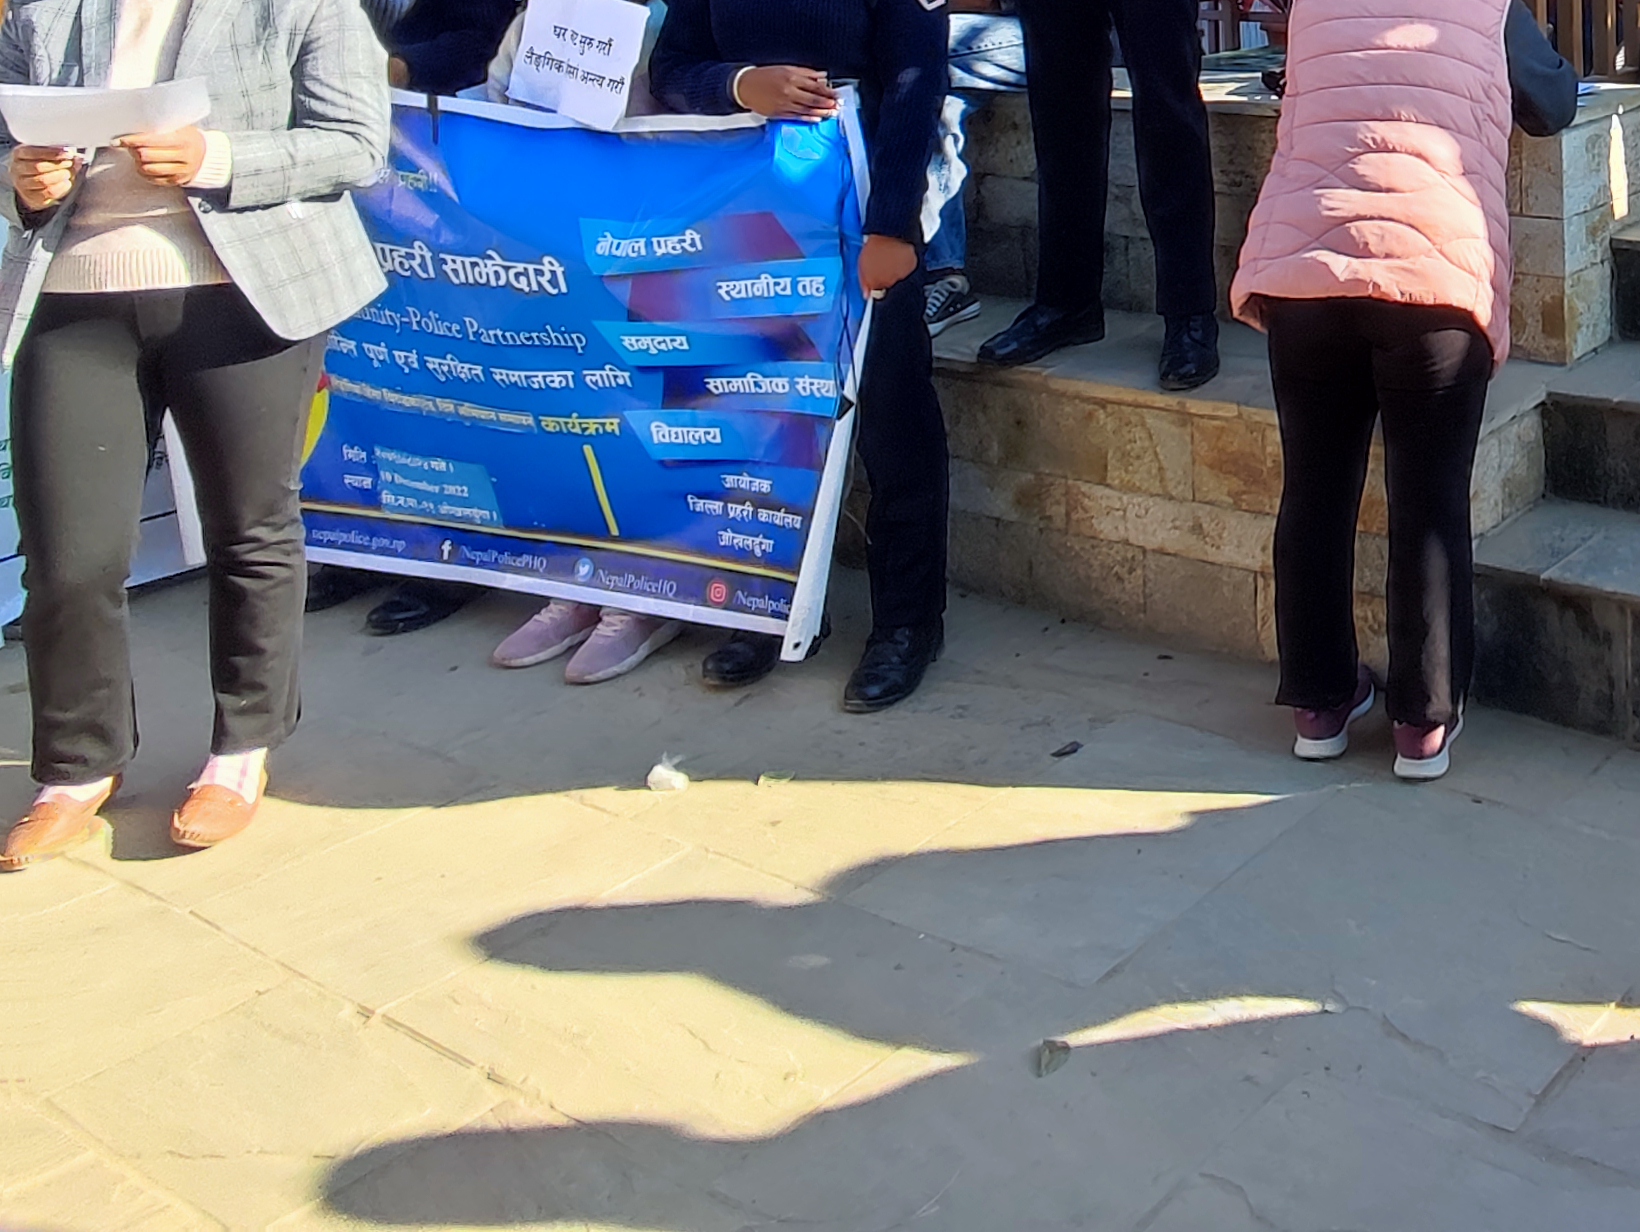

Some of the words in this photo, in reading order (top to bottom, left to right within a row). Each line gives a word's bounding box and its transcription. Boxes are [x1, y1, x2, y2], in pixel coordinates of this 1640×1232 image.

[595, 232, 646, 257] नेपाल
[652, 229, 703, 257] प्रहरी
[373, 240, 436, 280] प्रहरी
[439, 249, 569, 295] साझेदारी
[716, 274, 792, 302] स्थानीय
[797, 276, 826, 297] तह
[464, 317, 588, 353] Partnership
[620, 335, 690, 355] समुदाय
[582, 363, 633, 390] लागि
[704, 373, 789, 396] सामाजिक
[539, 413, 621, 437] कार्यक्रम
[650, 421, 722, 446] विद्यालय
[727, 501, 754, 523] प्रहरी
